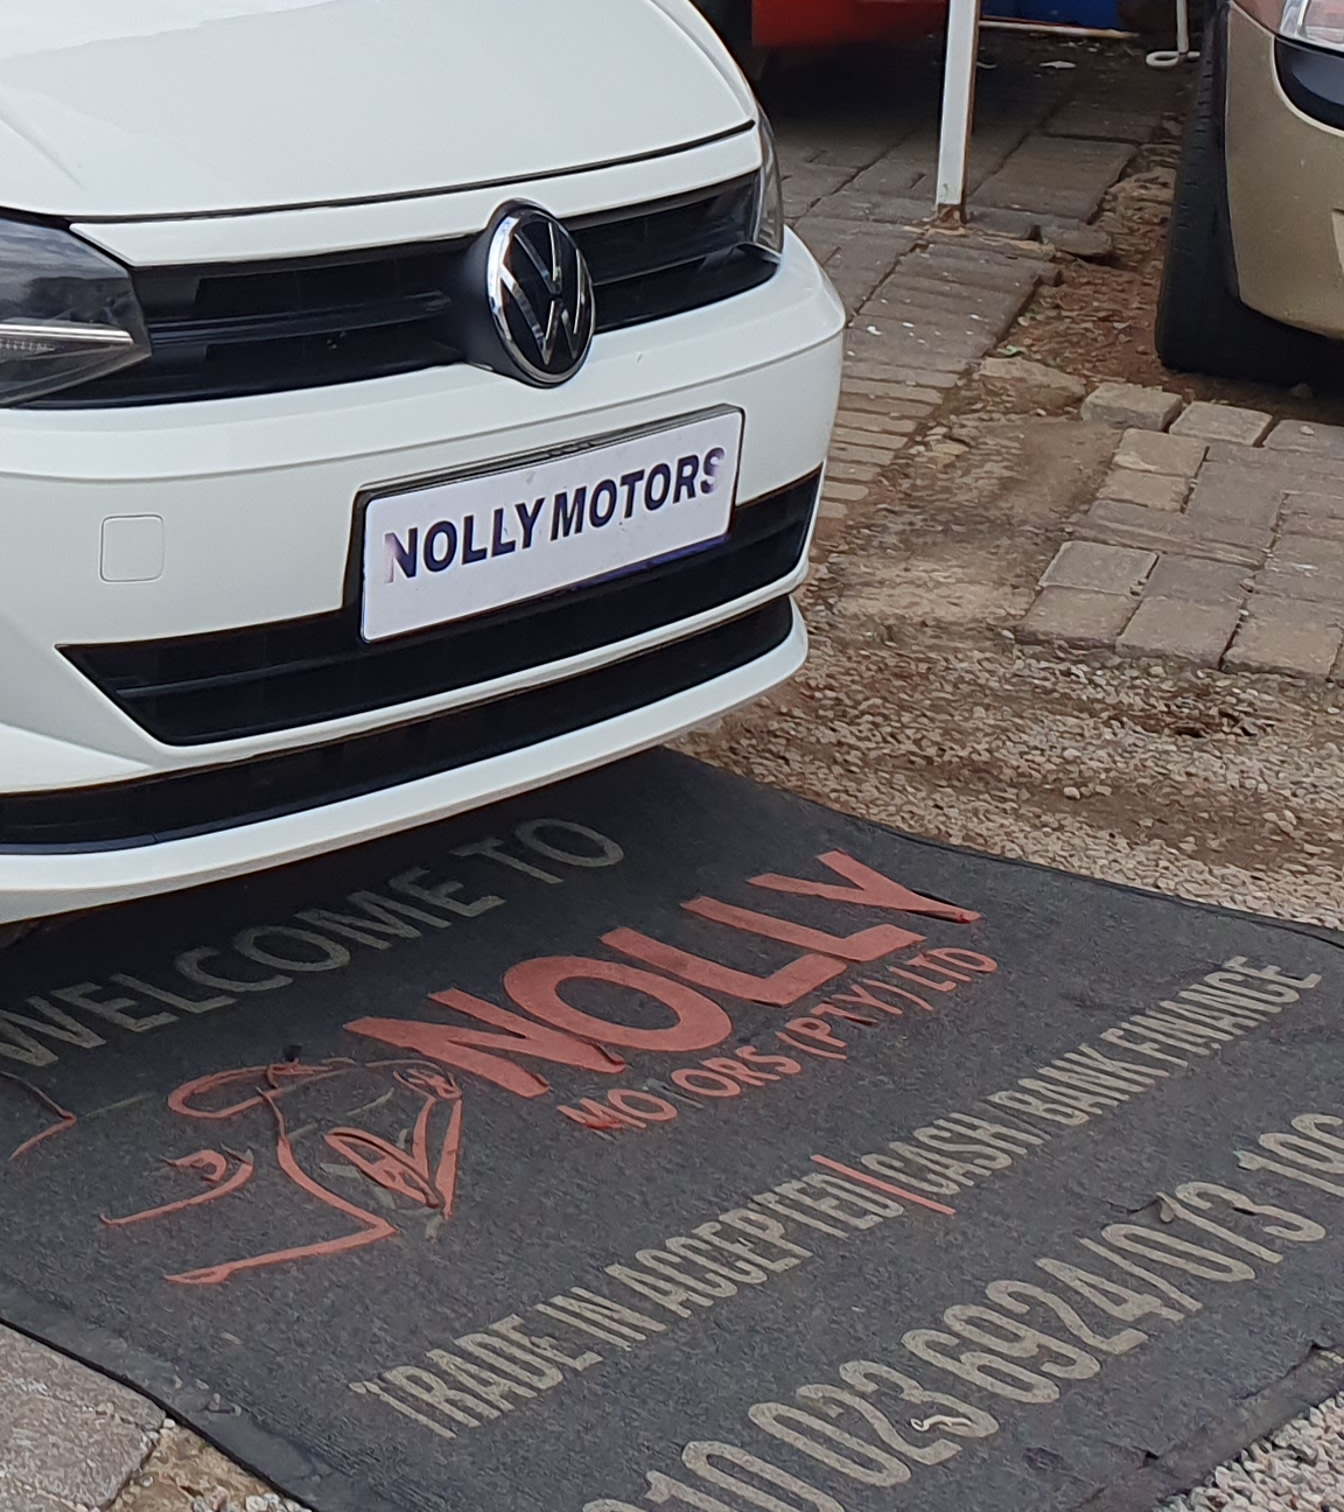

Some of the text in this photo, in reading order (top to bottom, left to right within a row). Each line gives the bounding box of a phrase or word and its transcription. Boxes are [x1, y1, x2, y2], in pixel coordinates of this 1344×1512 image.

[384, 447, 726, 584] NOLLY MOTORS
[449, 818, 625, 885] TO
[342, 848, 983, 1098] NOLLY
[774, 979, 934, 1060] (PTY)
[884, 947, 999, 993] LTD
[348, 1314, 604, 1440] TRADE
[533, 1286, 668, 1352] IN
[604, 1171, 905, 1319] ACCEPTED
[1100, 955, 1323, 1068] FINANCE
[748, 1360, 1000, 1488] 023
